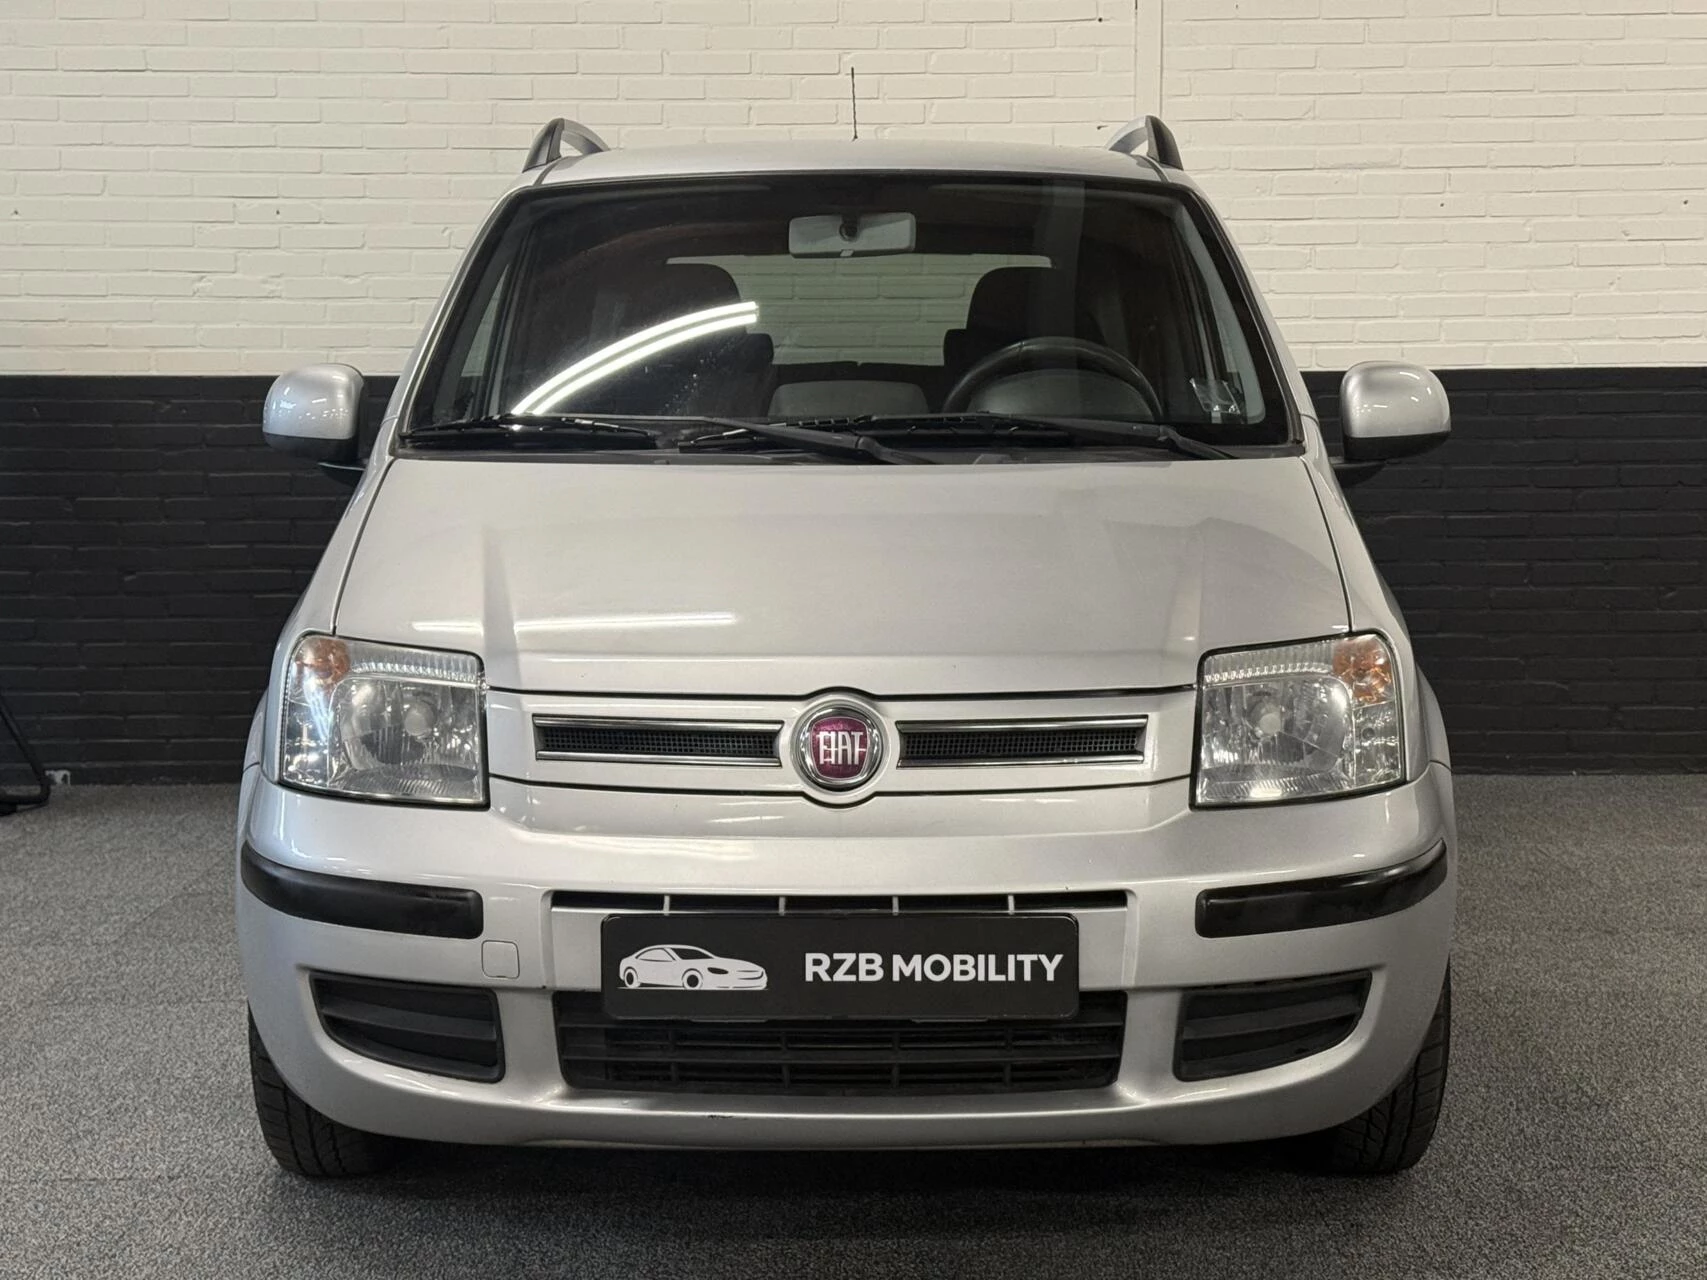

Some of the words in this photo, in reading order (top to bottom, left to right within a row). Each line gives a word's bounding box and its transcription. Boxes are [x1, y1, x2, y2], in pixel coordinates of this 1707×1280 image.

[816, 731, 866, 765] FIAT
[804, 952, 884, 982] RZB
[892, 953, 1064, 982] MOBILITY
